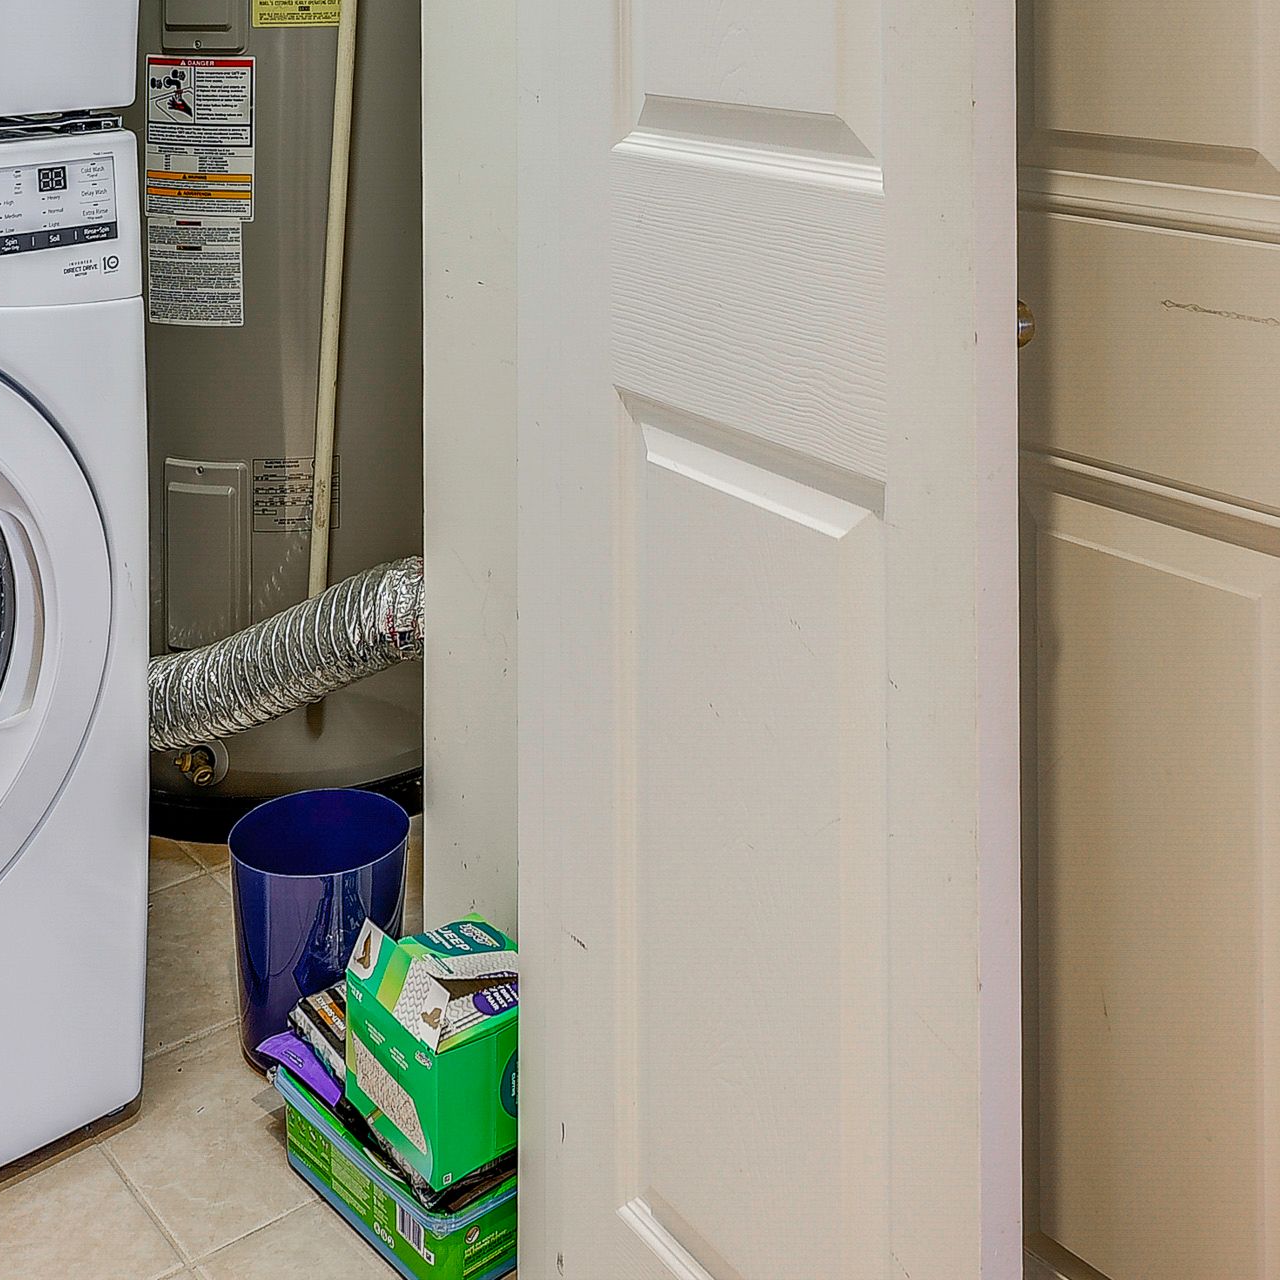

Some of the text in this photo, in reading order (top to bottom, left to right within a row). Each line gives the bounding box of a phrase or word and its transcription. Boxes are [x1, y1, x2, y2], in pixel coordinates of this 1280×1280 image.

[81, 190, 95, 198] Delay
[4, 238, 18, 247] Spin
[49, 234, 60, 243] Soil
[63, 255, 119, 275] DIRECT DRIVE 10
[492, 992, 508, 1008] DUST
[499, 989, 514, 1002] DIRT
[485, 995, 500, 1011] HAIR
